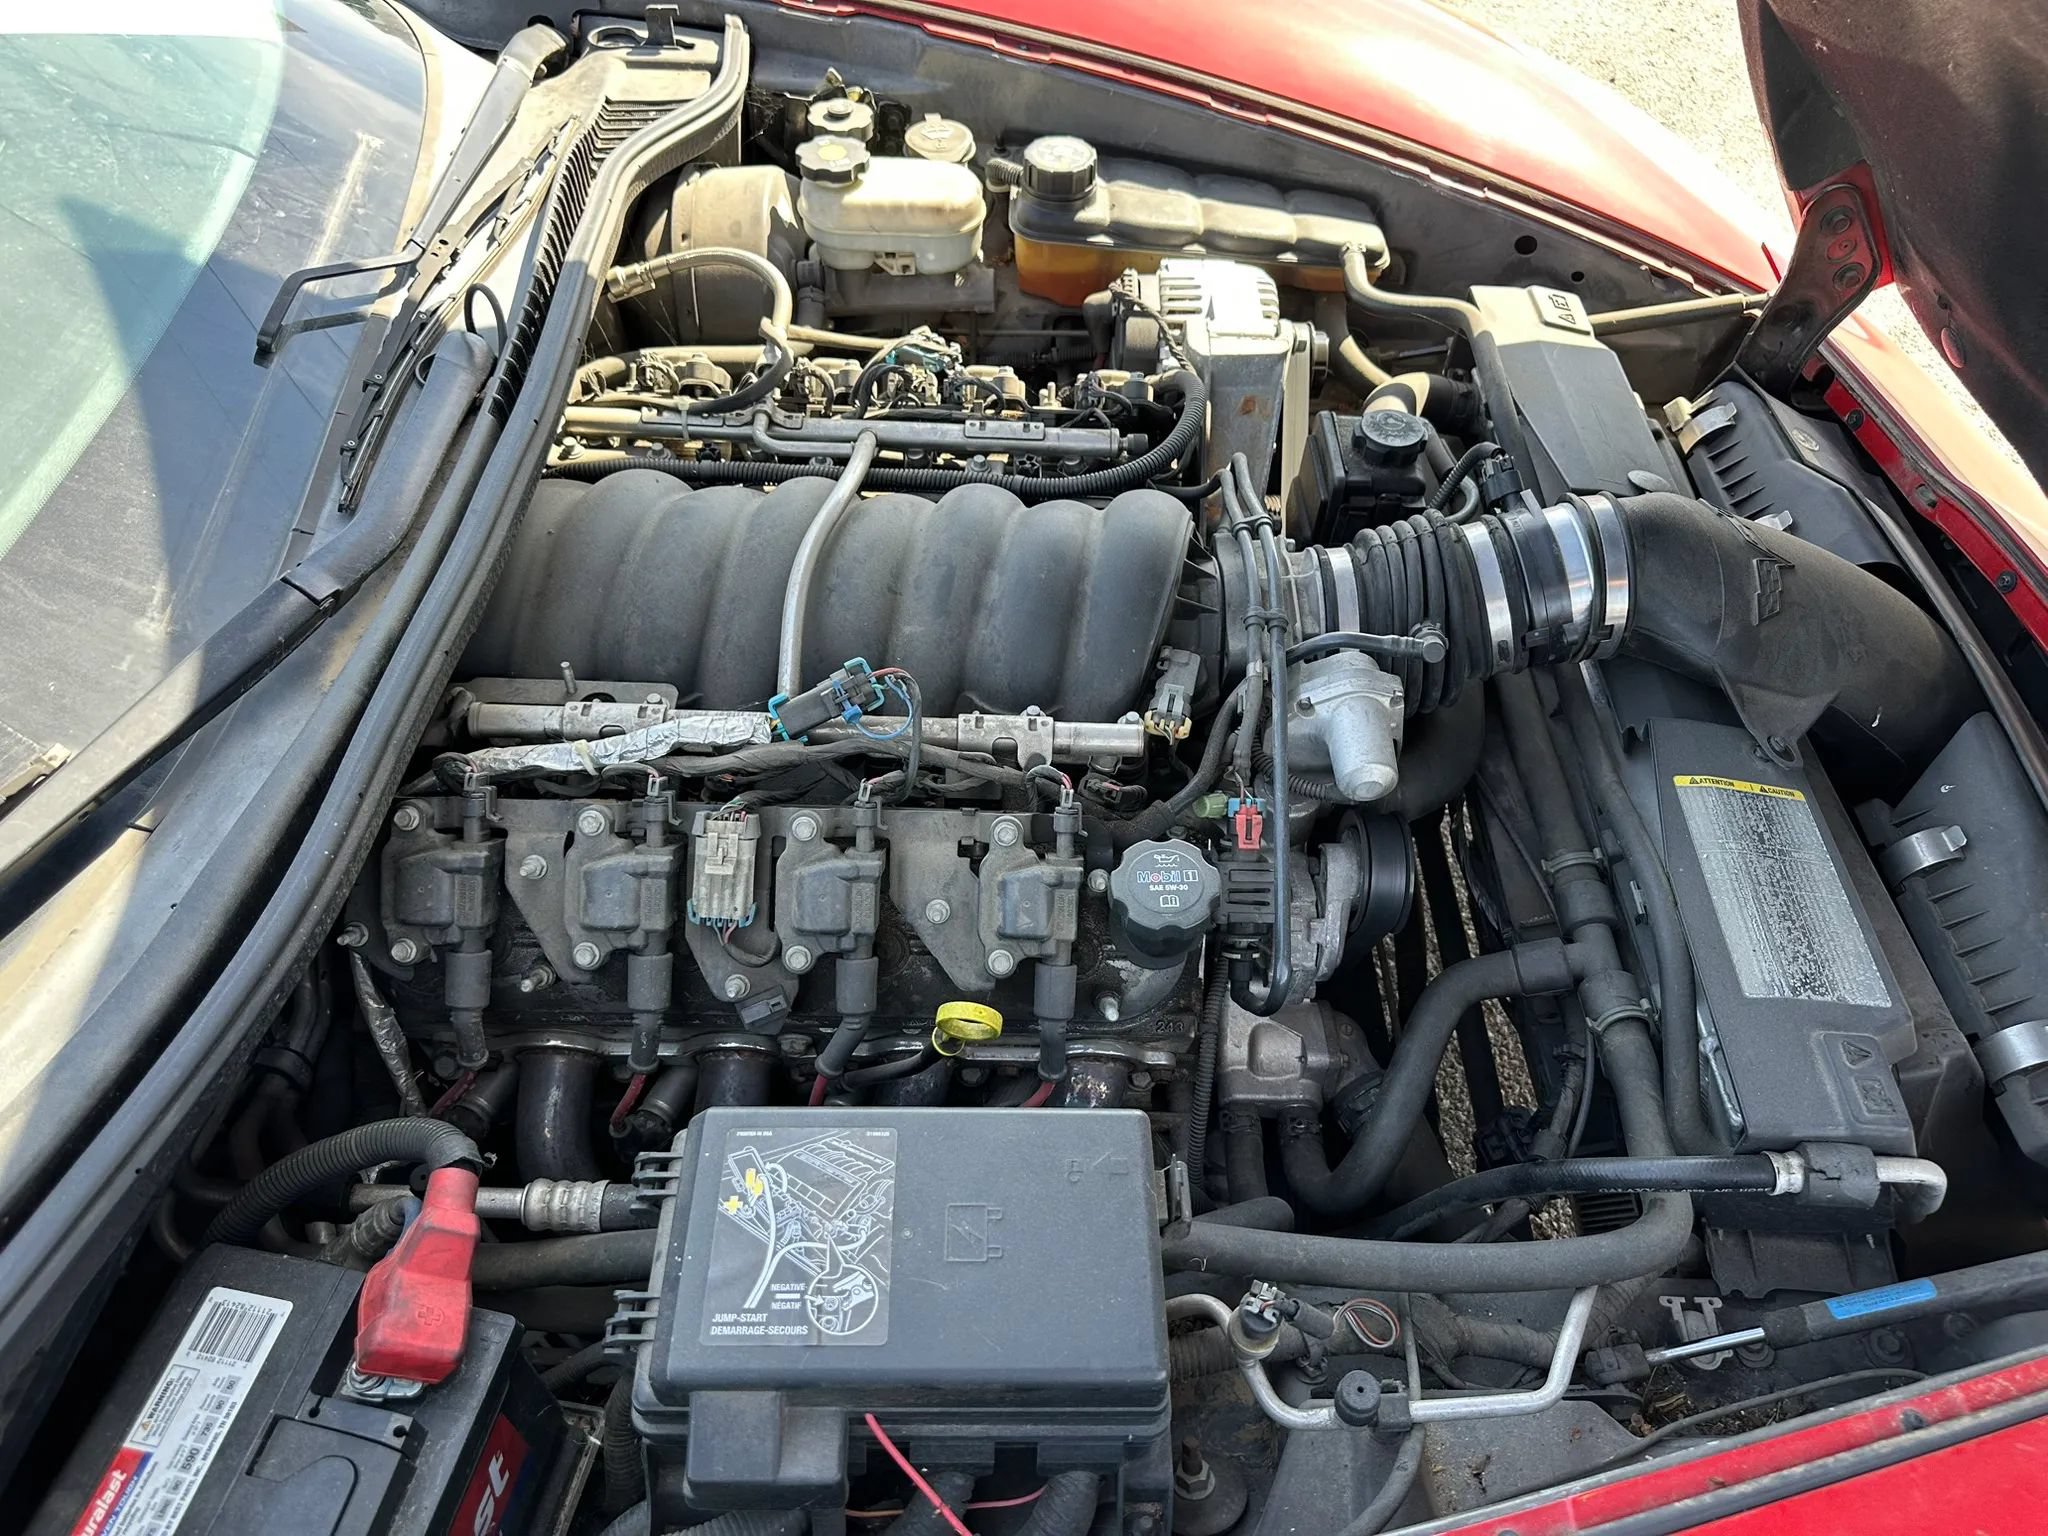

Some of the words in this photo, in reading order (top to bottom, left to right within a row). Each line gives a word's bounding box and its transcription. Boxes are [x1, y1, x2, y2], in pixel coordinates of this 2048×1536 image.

[1700, 778, 1735, 787] ATTENTION
[1767, 787, 1795, 797] CAUTION
[1137, 871, 1181, 883] Mobil
[1155, 1020, 1184, 1032] 243
[771, 1283, 805, 1291] NEGATIVE
[712, 1313, 768, 1322] JUMP-START
[148, 1378, 174, 1420] WARNING:
[180, 1447, 201, 1471] 590
[199, 1421, 214, 1437] 735
[114, 1476, 138, 1513] TOUGH
[80, 1469, 127, 1536] uralast
